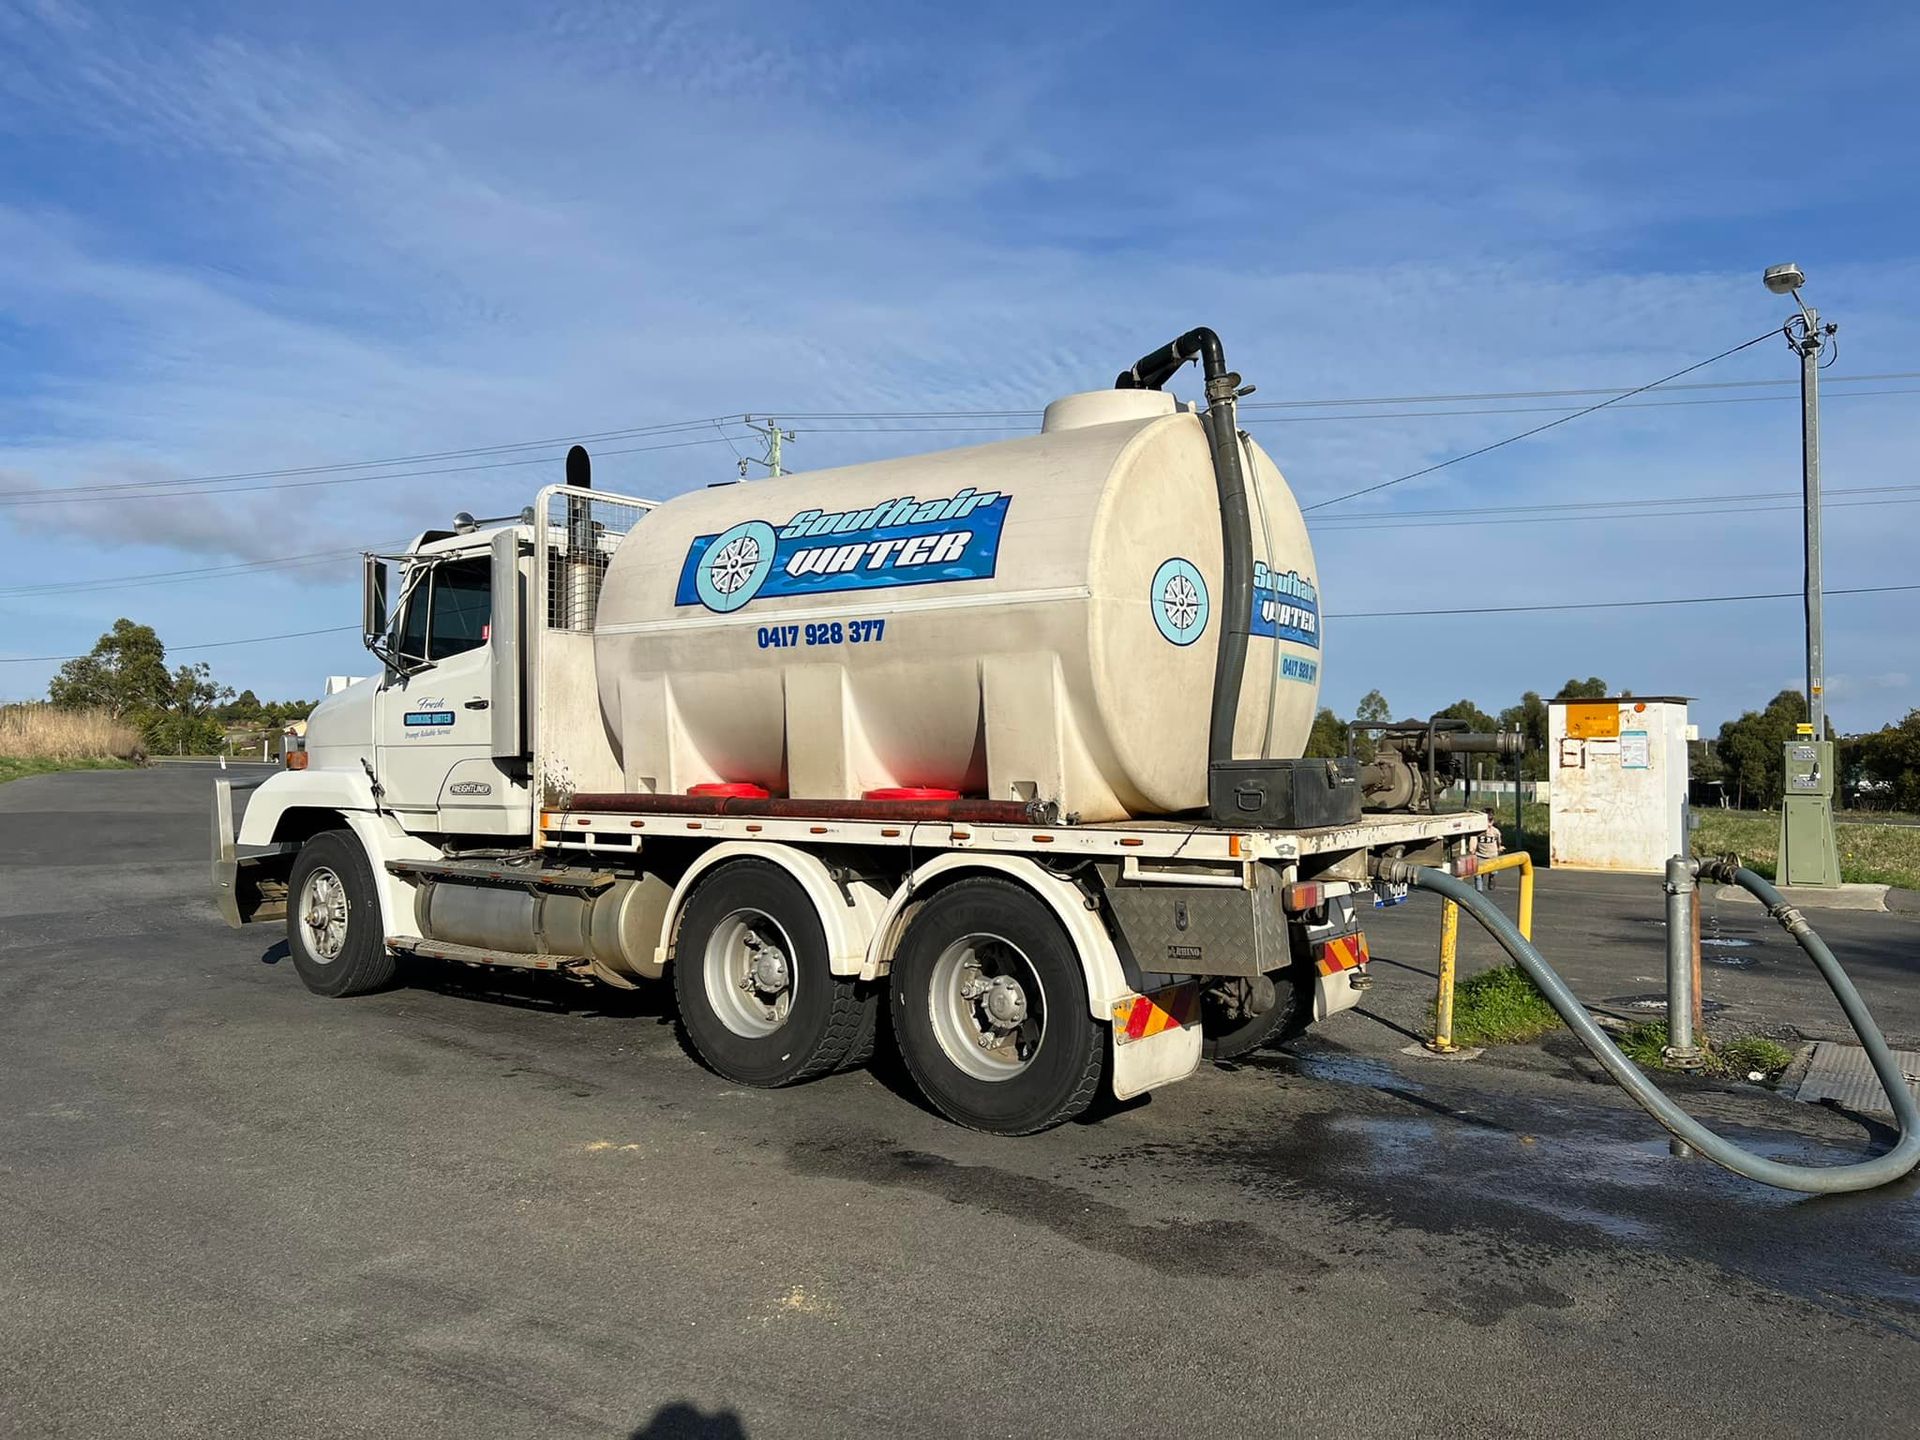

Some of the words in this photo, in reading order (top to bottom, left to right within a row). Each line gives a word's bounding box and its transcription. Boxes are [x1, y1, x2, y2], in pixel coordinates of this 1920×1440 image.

[779, 488, 1001, 539] Southair
[786, 531, 974, 577] WATER
[1261, 599, 1315, 633] WATER
[757, 624, 799, 648] 0417
[805, 622, 843, 646] 928
[848, 619, 885, 643] 377
[416, 697, 445, 710] Fresh
